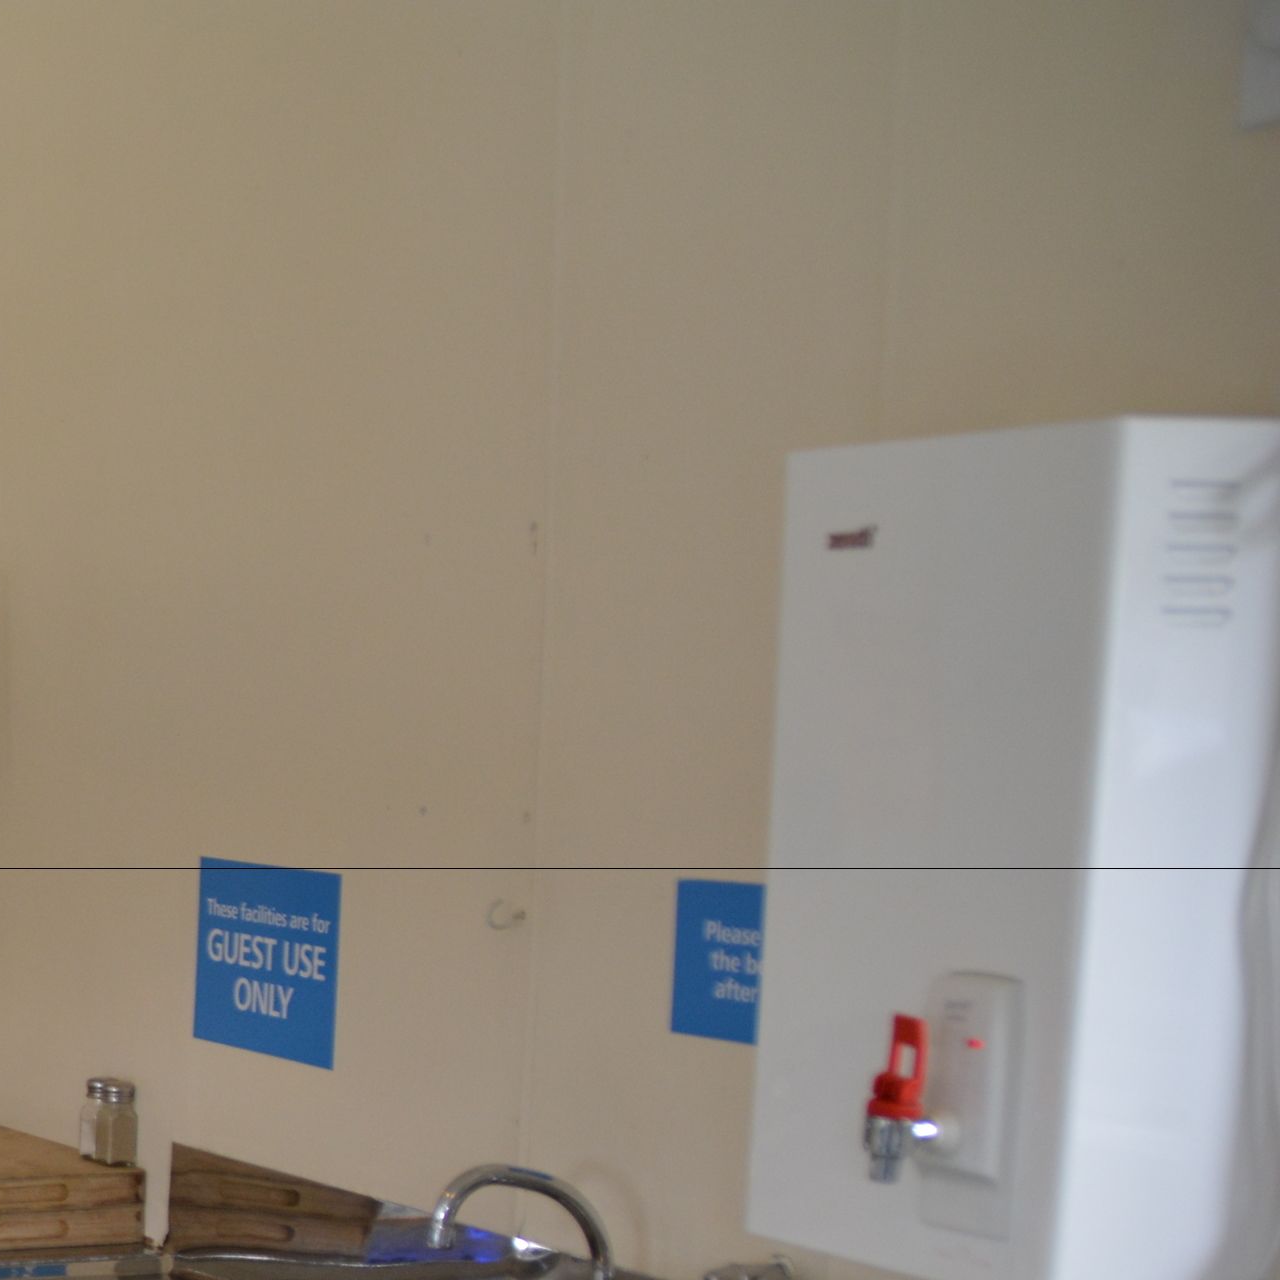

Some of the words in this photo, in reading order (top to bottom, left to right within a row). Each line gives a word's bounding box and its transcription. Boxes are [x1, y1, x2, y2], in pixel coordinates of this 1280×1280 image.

[207, 898, 239, 919] These
[240, 902, 287, 928] facilities
[290, 915, 310, 931] are
[312, 913, 331, 934] for
[704, 919, 761, 946] Please
[207, 928, 277, 971] GUEST
[283, 941, 327, 981] USE
[710, 949, 740, 973] the
[235, 977, 294, 1019] ONLY
[714, 977, 760, 1002] after
